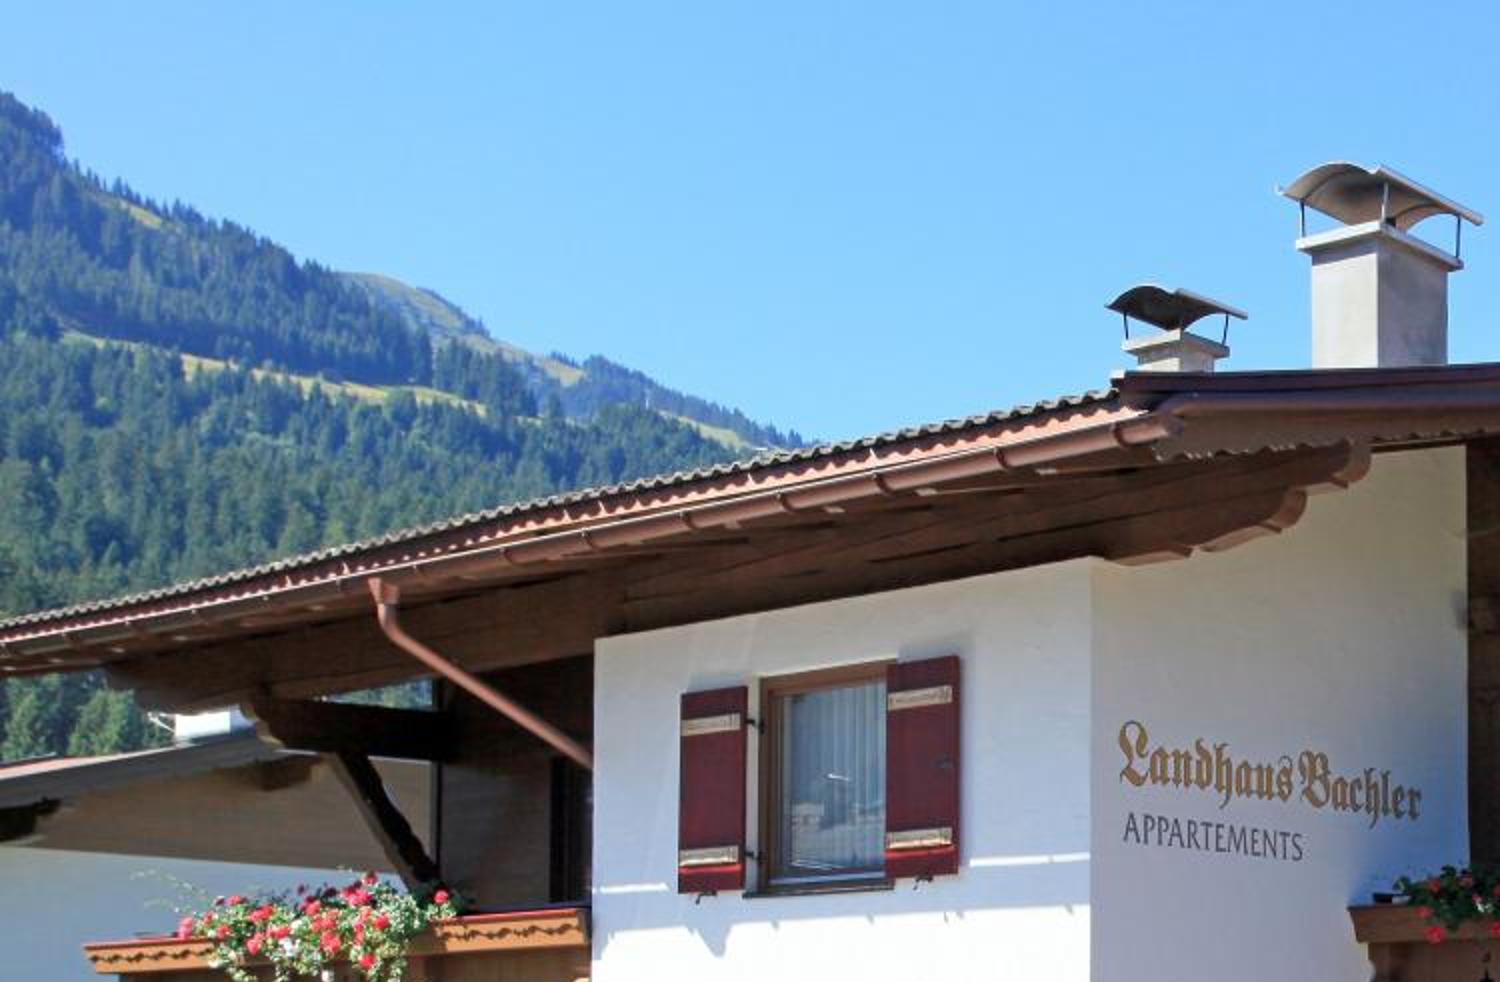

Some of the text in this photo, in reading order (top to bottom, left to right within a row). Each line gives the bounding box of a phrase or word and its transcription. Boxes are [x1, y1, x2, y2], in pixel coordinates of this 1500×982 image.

[1118, 719, 1422, 829] Landhaus Bachler
[1123, 812, 1304, 862] APPARTEMENTS
